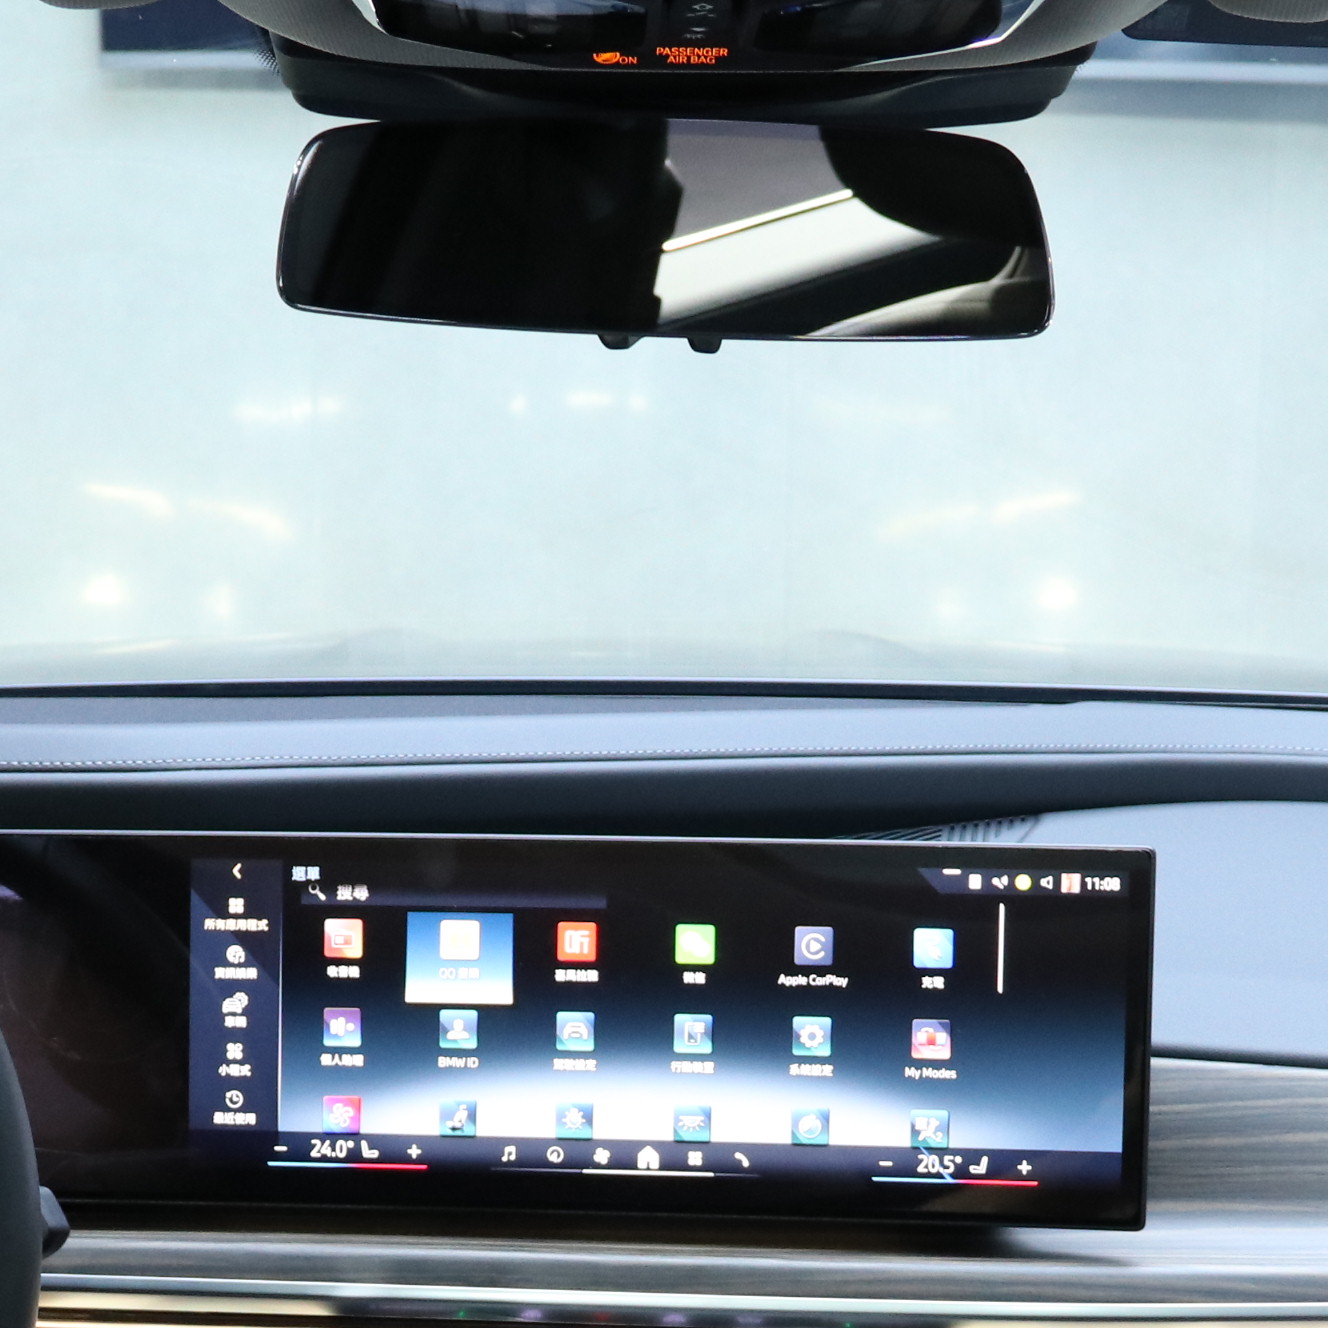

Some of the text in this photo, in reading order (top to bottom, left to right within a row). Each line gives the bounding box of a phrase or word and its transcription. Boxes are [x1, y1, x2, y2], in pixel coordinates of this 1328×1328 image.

[656, 47, 728, 57] PASSENGER
[619, 56, 637, 64] ON
[667, 56, 716, 64] AIR BAG
[291, 866, 321, 881] 選單
[1084, 876, 1121, 891] 11:08
[336, 885, 370, 901] 搜尋
[204, 918, 269, 932] 所有應用程式
[777, 973, 849, 988] Apple CarPlay
[438, 1056, 480, 1069] BMW ID
[904, 1066, 957, 1080] My Modes
